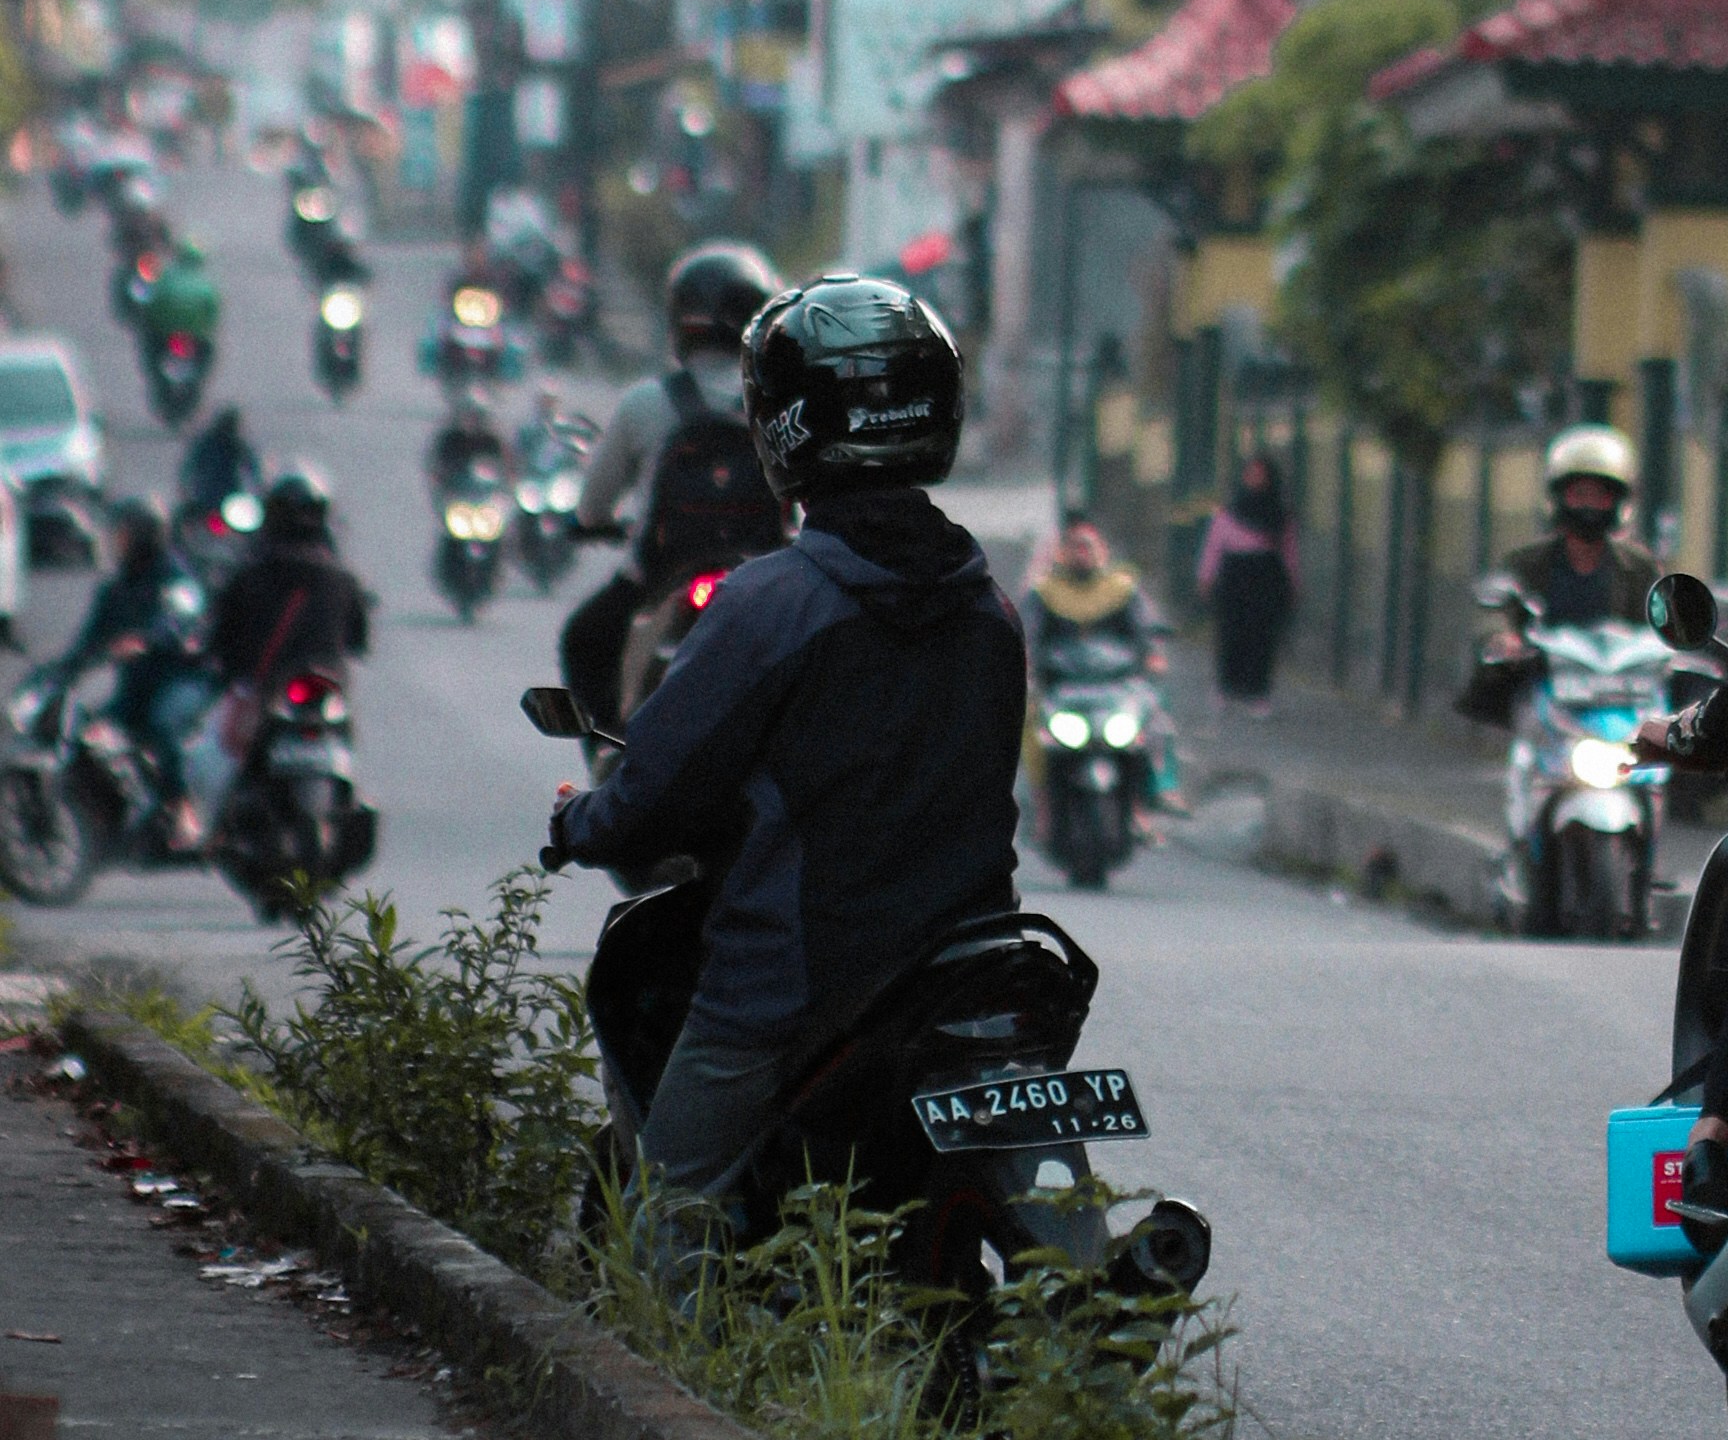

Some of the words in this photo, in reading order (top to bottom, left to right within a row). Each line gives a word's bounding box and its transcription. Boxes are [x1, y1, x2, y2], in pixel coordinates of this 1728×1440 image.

[926, 1096, 971, 1124] AA
[985, 1079, 1067, 1117] 2460
[1084, 1074, 1126, 1102] YP
